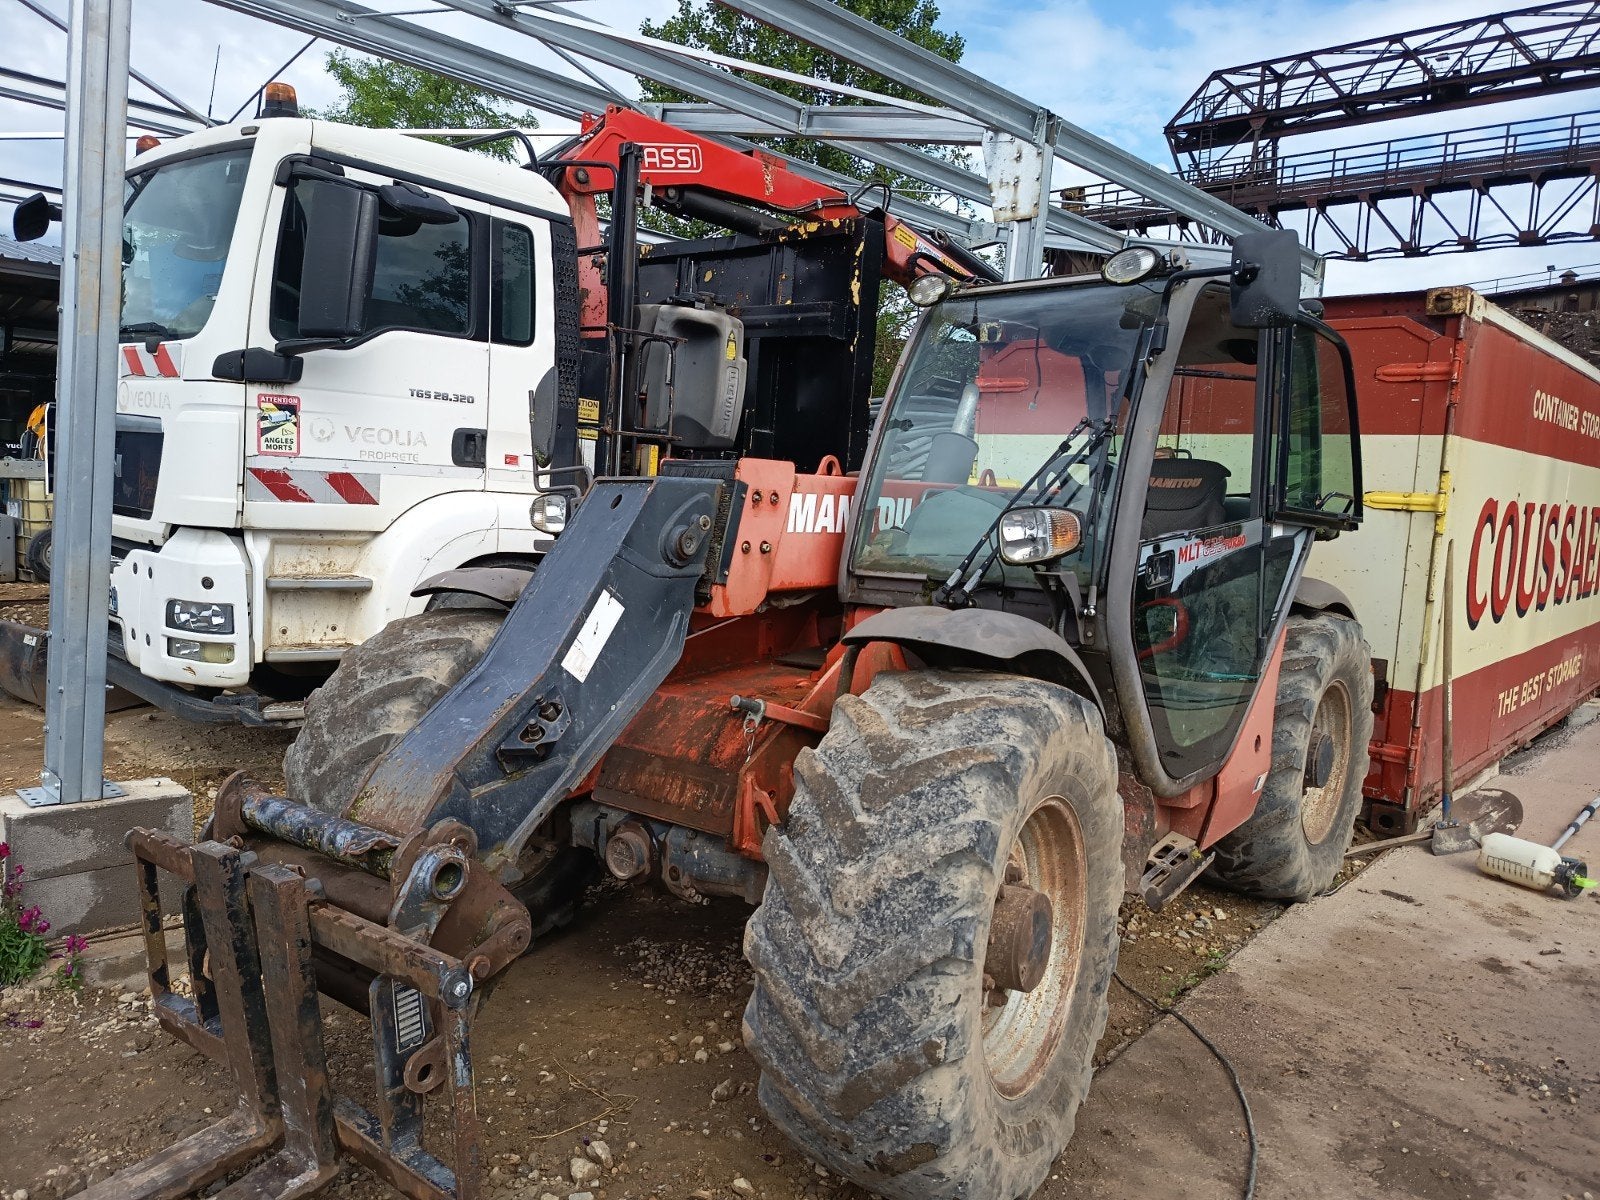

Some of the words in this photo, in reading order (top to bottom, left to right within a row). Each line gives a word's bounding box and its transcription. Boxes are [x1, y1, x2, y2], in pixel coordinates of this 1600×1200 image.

[643, 147, 697, 168] ASSI
[130, 390, 172, 410] VEOLIA
[260, 396, 299, 404] ATTENTION
[408, 388, 432, 399] TGS
[433, 391, 475, 404] 28.320
[579, 400, 599, 409] TION
[1533, 389, 1579, 431] CONTAINER
[1580, 410, 1600, 440] STOR
[264, 437, 295, 445] ANGLES
[344, 425, 428, 447] VEOLIA
[359, 450, 419, 463] PROPRETE
[786, 492, 913, 533] MANOU
[1178, 541, 1202, 564] MLT
[1466, 497, 1600, 631] COUSSAE
[1497, 685, 1520, 719] THE
[1521, 672, 1546, 704] BEST
[1546, 654, 1581, 691] STORAGE
